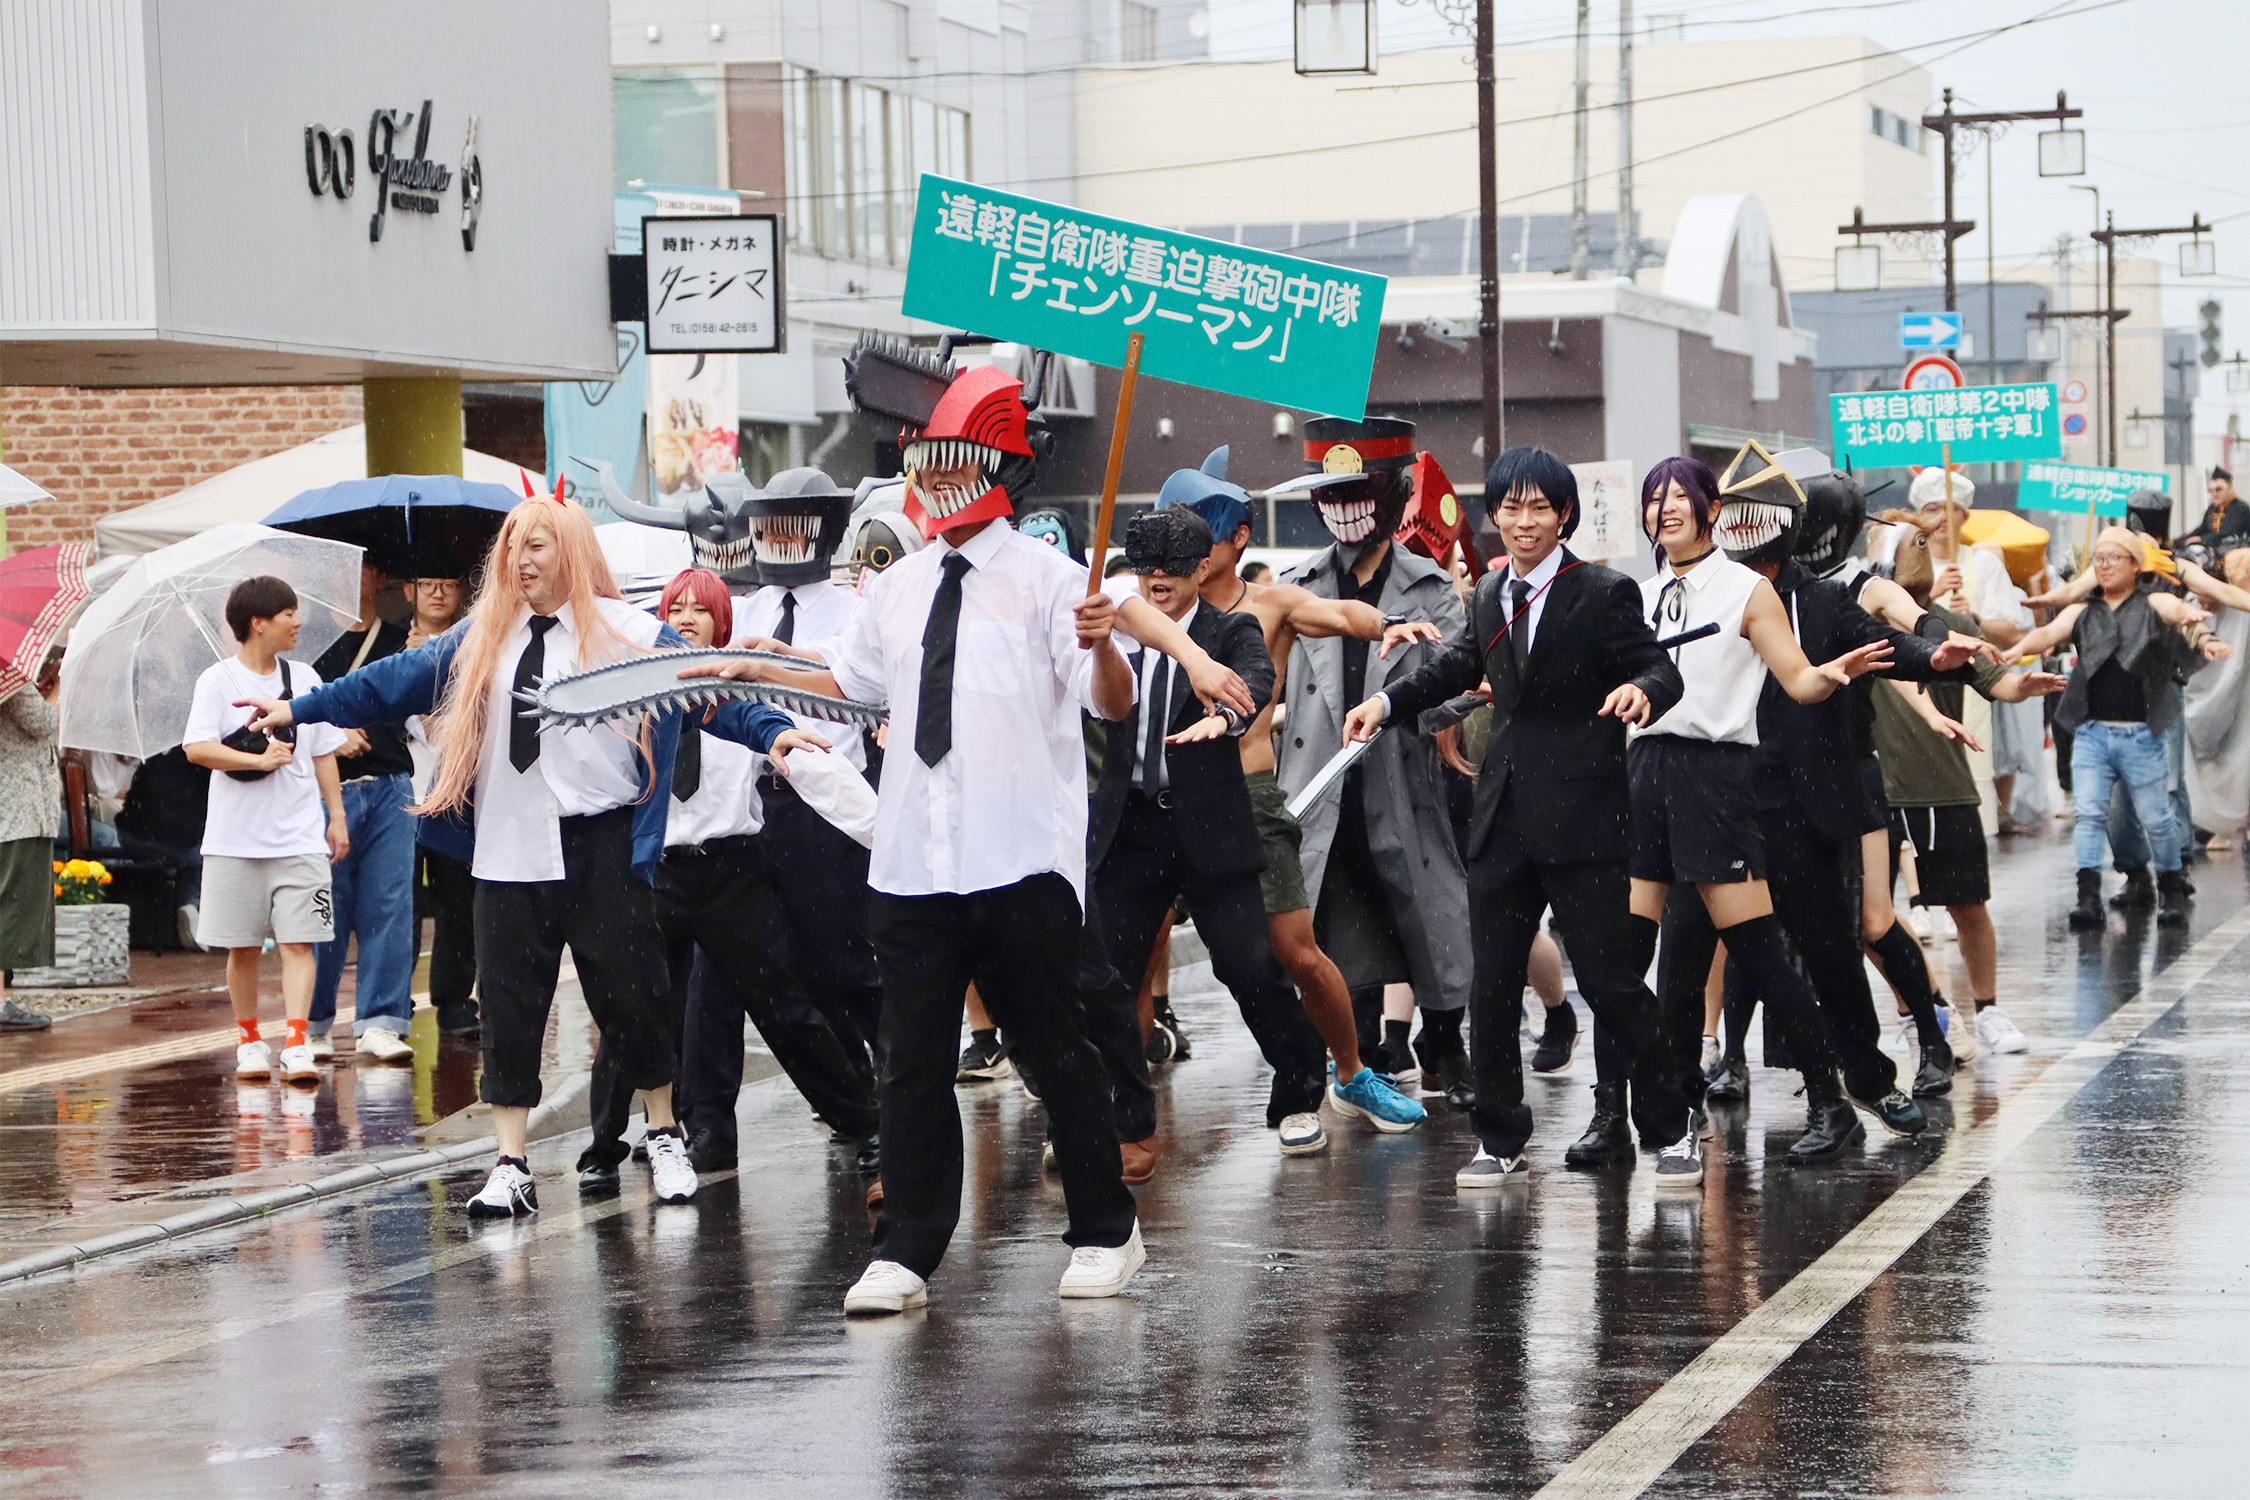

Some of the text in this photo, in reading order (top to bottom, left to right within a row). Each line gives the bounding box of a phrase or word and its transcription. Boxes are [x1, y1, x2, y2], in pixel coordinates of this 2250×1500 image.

[662, 236, 756, 251] 時計・メガネ
[935, 191, 1361, 327] 遠軽自衛隊重迫撃砲中隊
[655, 266, 768, 315] タニシマ
[989, 251, 1292, 363] 「チェンソーマン」
[1838, 387, 2051, 422] 遠軽自衛隊第2中隊
[2051, 482, 2134, 504] 「ショッカー
